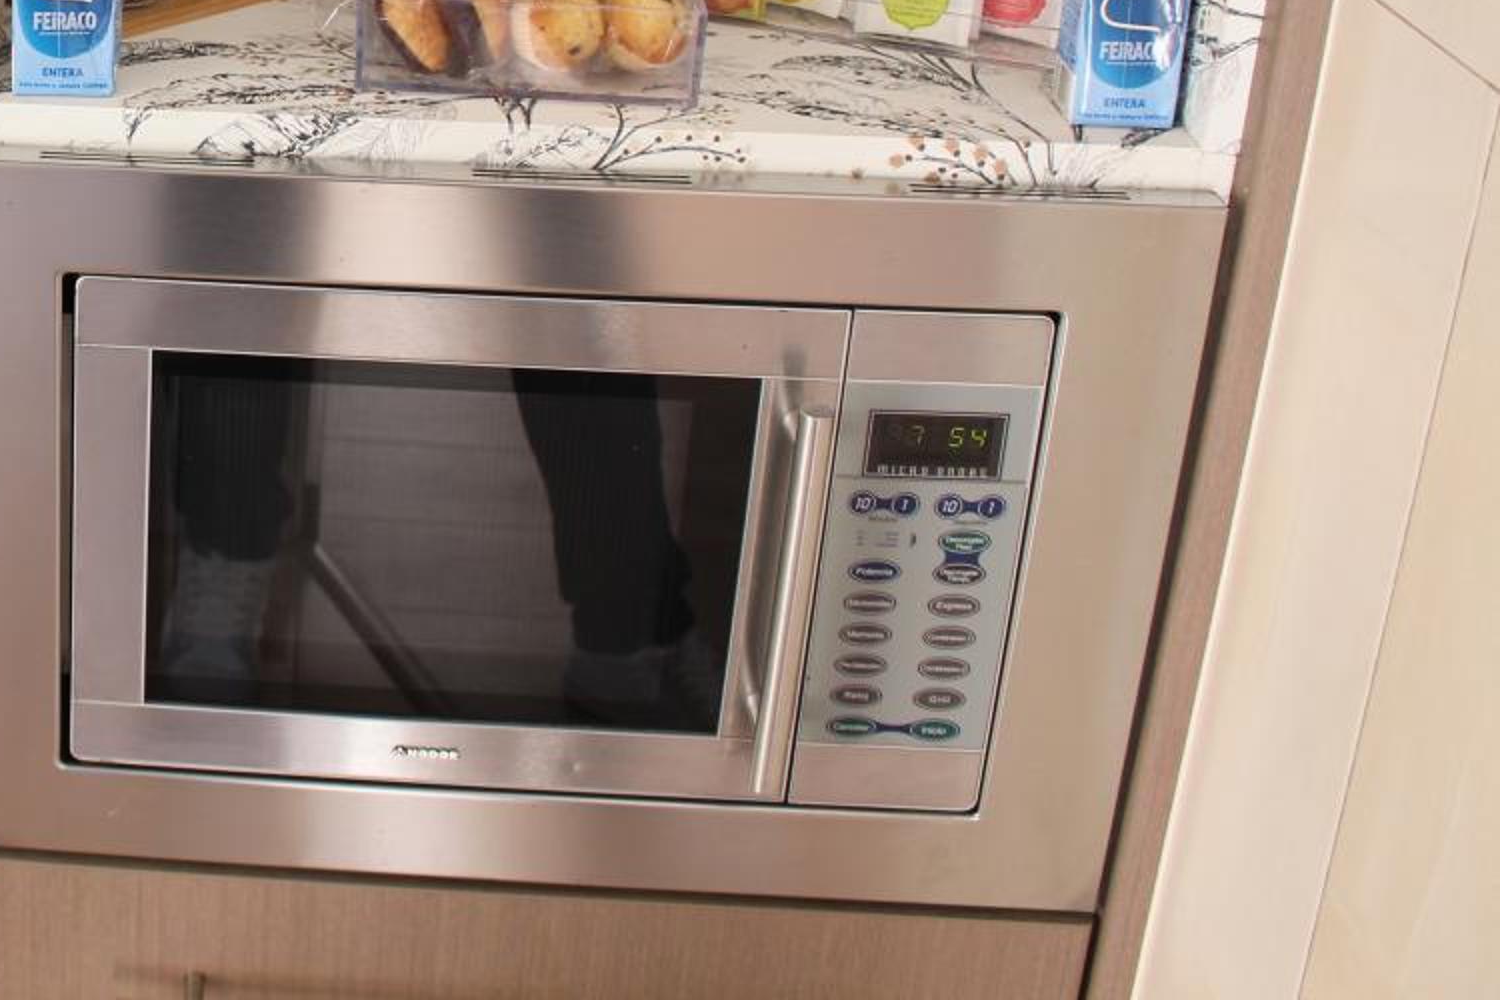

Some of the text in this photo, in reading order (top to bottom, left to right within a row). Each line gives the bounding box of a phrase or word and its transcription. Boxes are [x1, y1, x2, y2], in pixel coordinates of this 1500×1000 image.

[33, 11, 97, 31] FEIRACO
[948, 427, 987, 449] 54
[942, 500, 959, 513] 10
